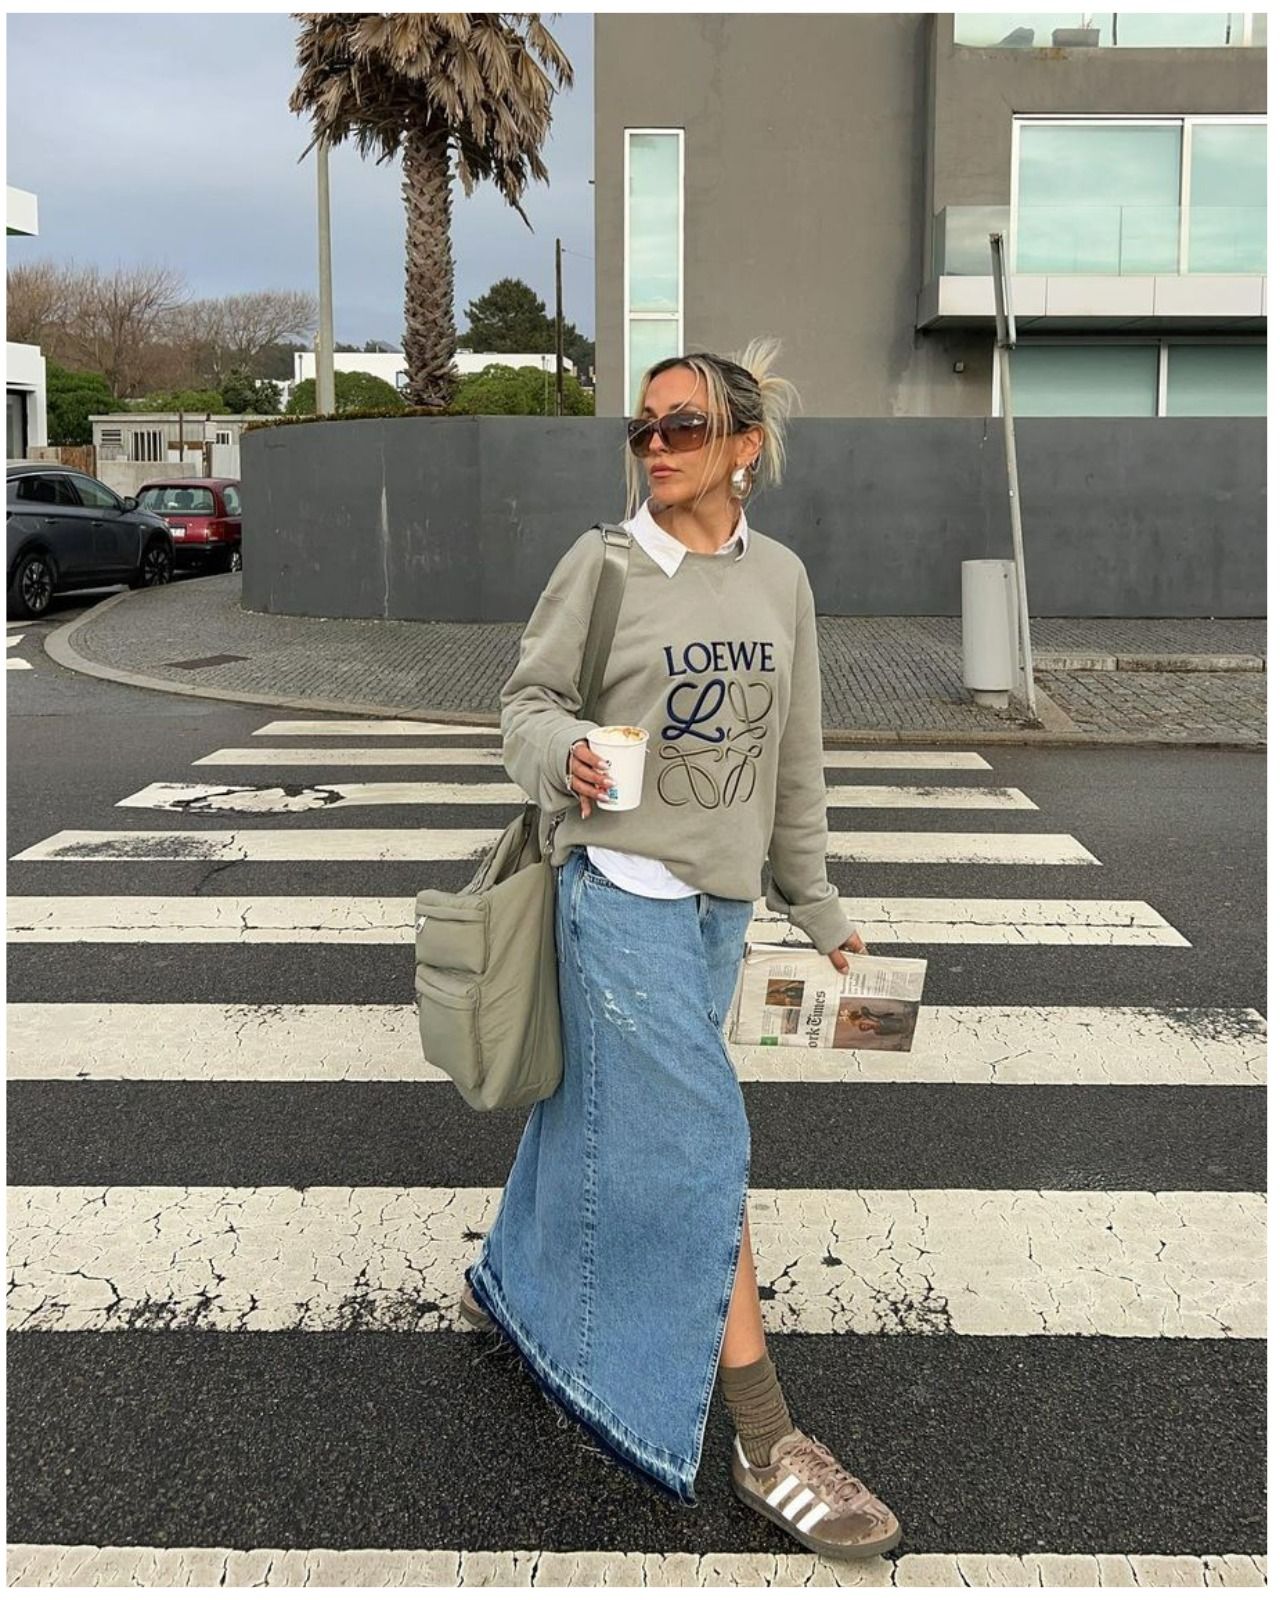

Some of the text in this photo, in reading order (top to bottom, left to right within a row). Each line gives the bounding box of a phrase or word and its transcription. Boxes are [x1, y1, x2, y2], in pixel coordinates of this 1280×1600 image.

[663, 641, 775, 677] LOEWE
[805, 989, 826, 1049] ork Times
